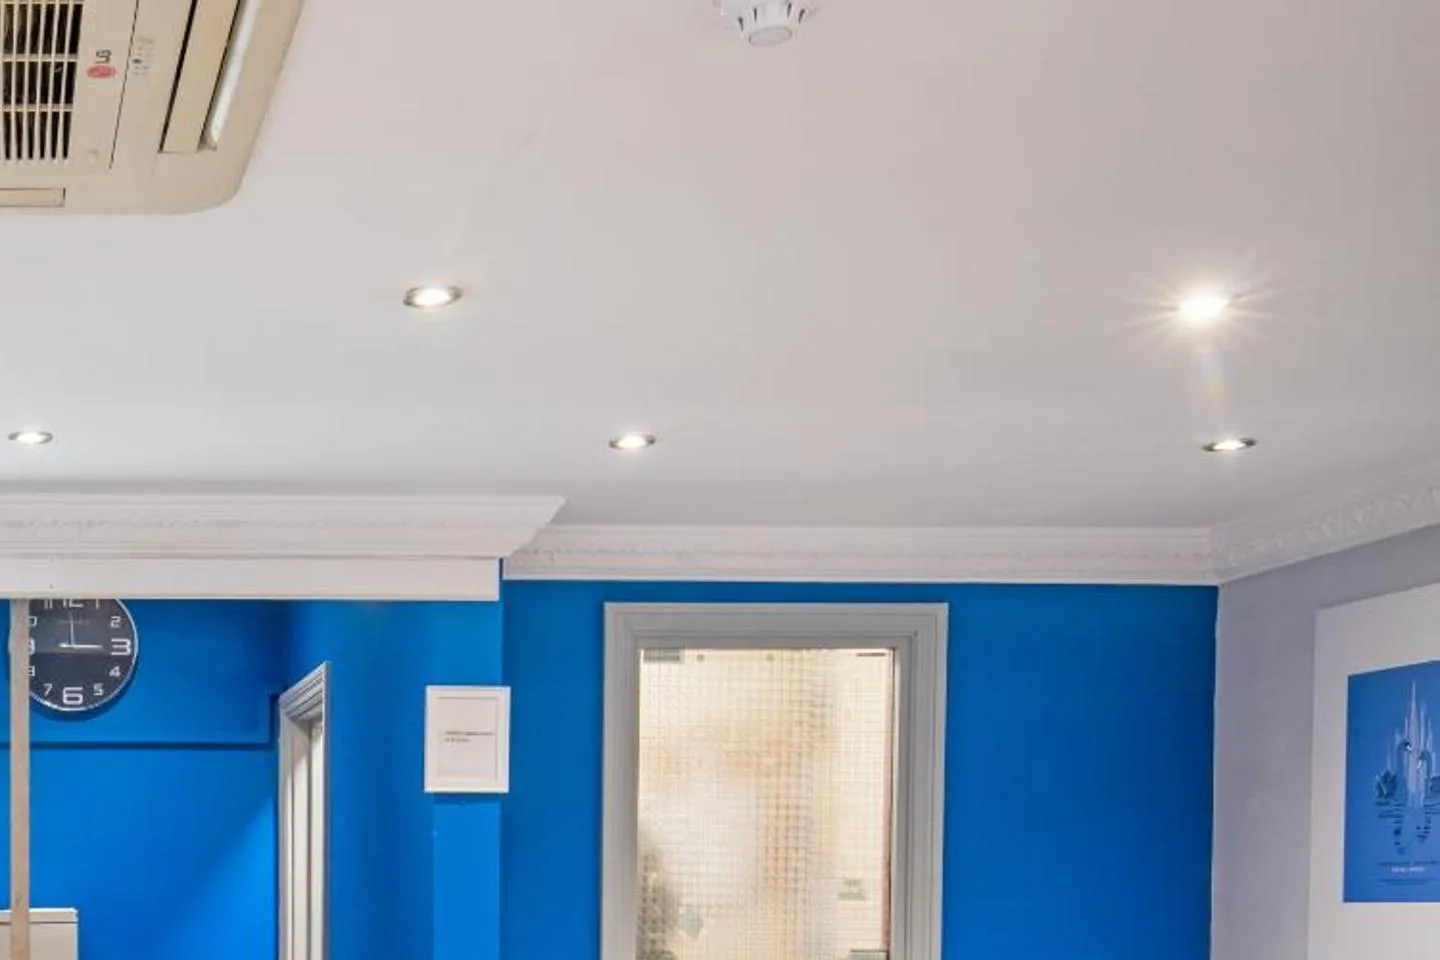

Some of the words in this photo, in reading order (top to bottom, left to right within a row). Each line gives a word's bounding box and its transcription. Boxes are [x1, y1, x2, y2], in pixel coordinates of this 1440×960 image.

[110, 615, 121, 628] 2
[110, 638, 131, 656] 3
[109, 666, 120, 677] 4
[43, 683, 53, 696] 7
[63, 687, 83, 705] 6
[93, 683, 104, 696] 5
